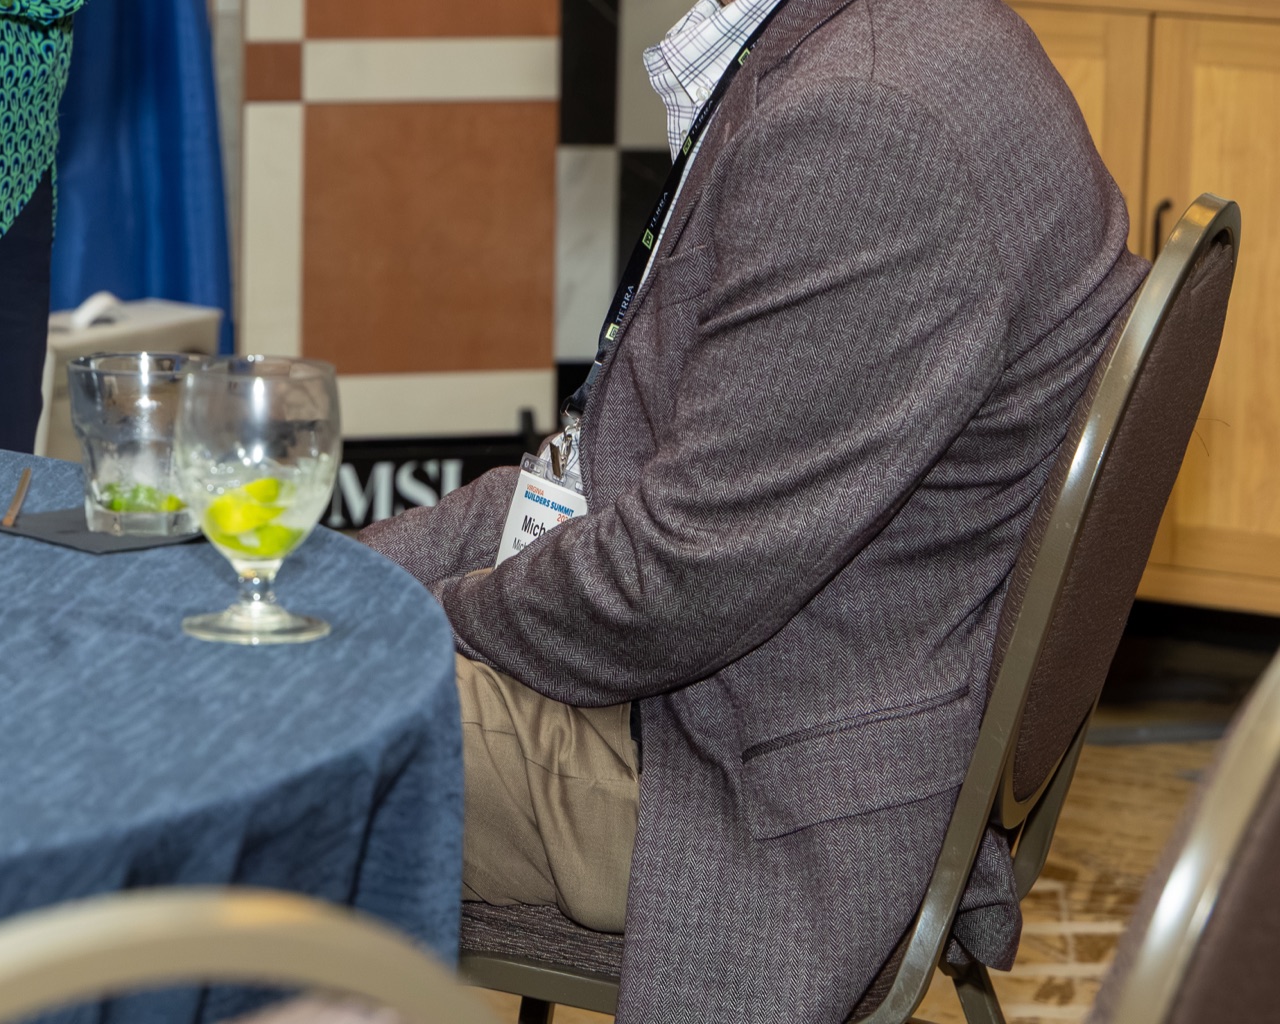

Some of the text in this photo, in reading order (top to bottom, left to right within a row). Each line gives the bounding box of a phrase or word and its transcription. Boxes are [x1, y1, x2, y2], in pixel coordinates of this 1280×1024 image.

[615, 285, 634, 323] TERRA
[524, 490, 574, 517] BUILDERS SUMMIT
